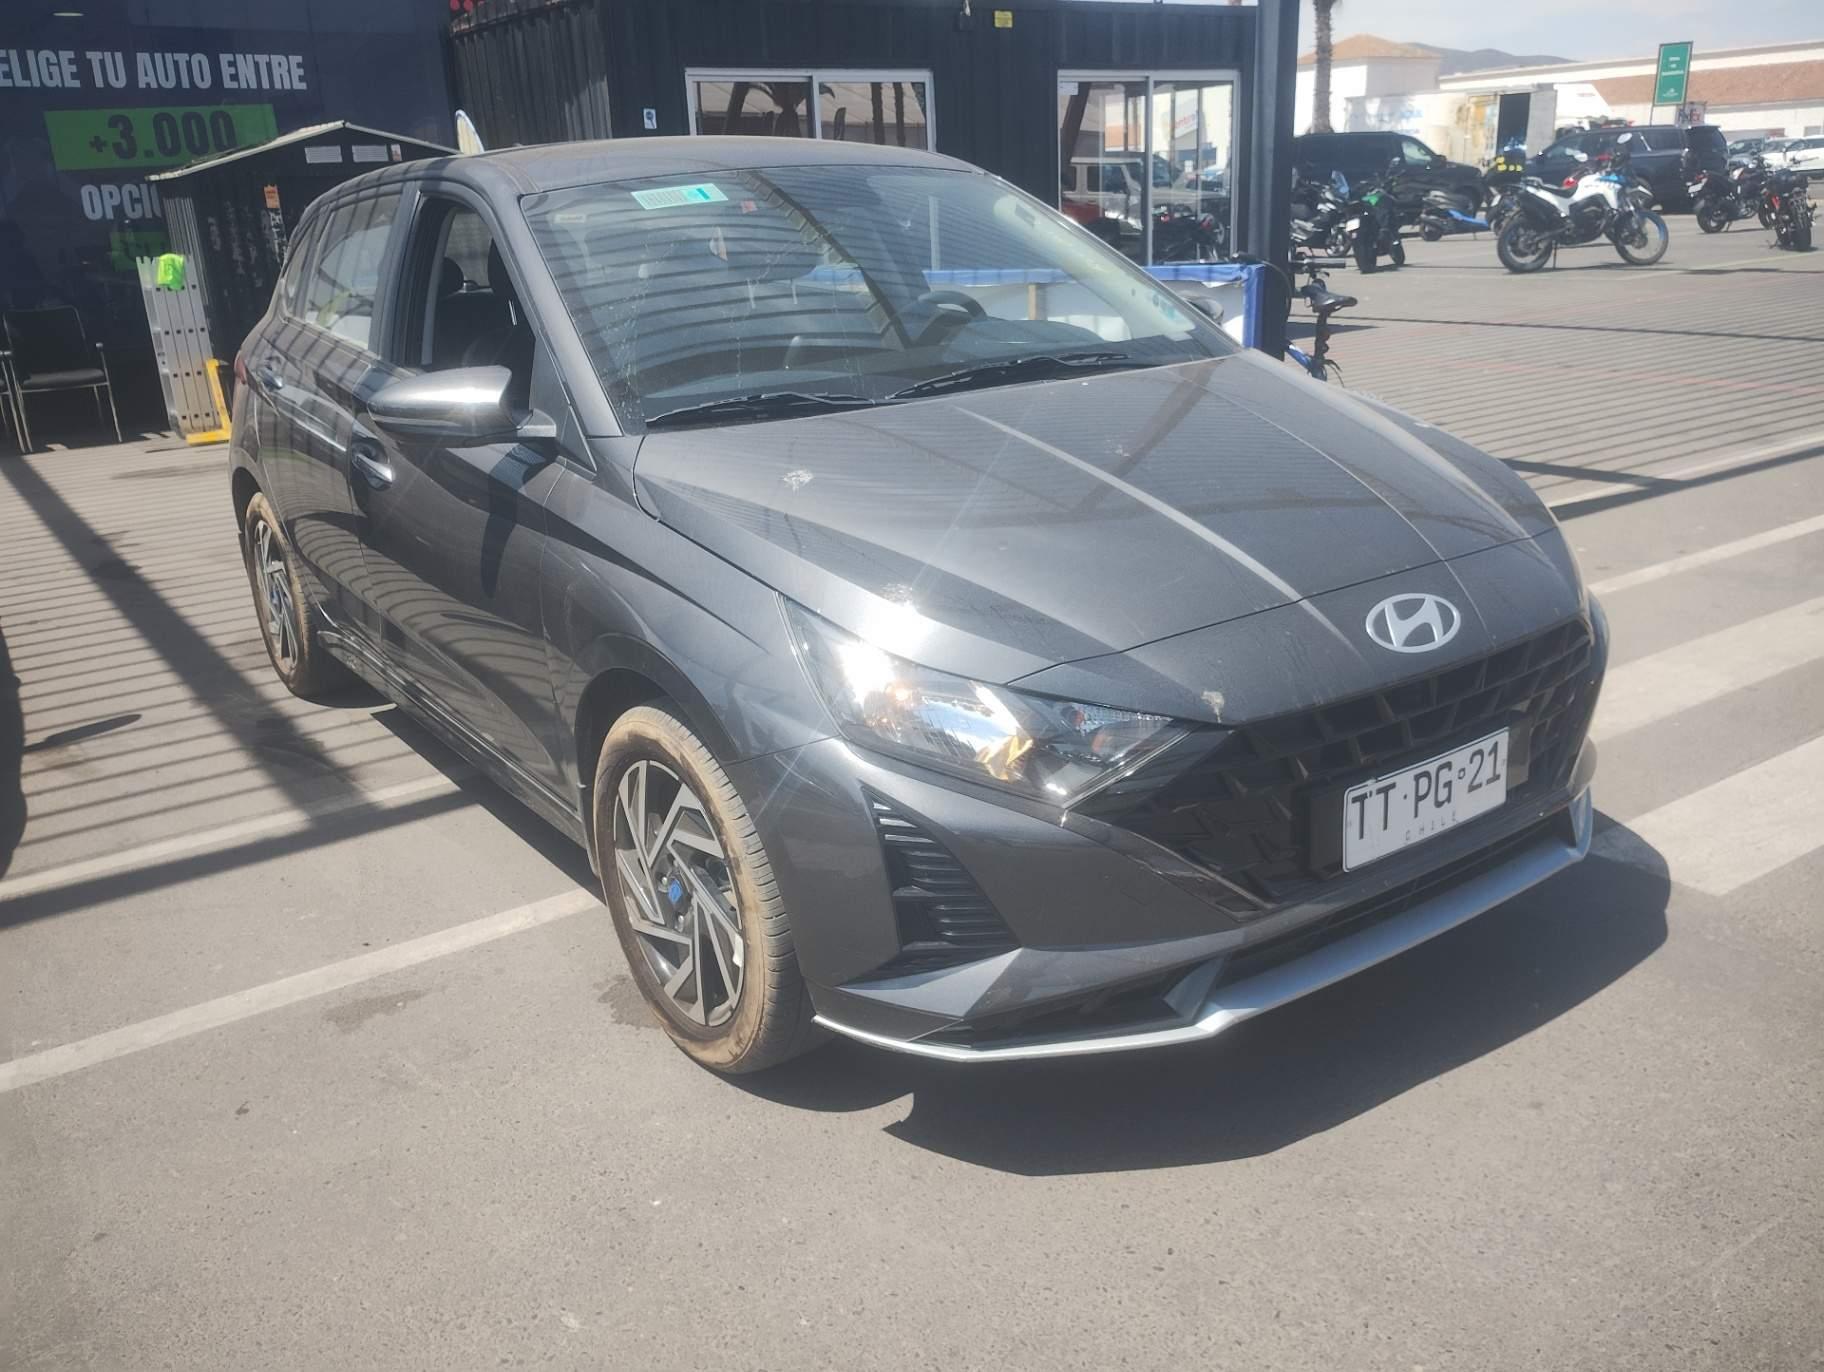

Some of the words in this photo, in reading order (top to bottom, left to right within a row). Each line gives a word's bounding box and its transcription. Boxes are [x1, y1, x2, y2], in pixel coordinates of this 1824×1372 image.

[0, 49, 81, 88] ELIGE
[85, 51, 127, 88] TU
[136, 52, 212, 89] AUTO
[219, 53, 307, 90] ENTRE
[89, 110, 238, 160] +3.000
[1405, 810, 1457, 841] CHILE
